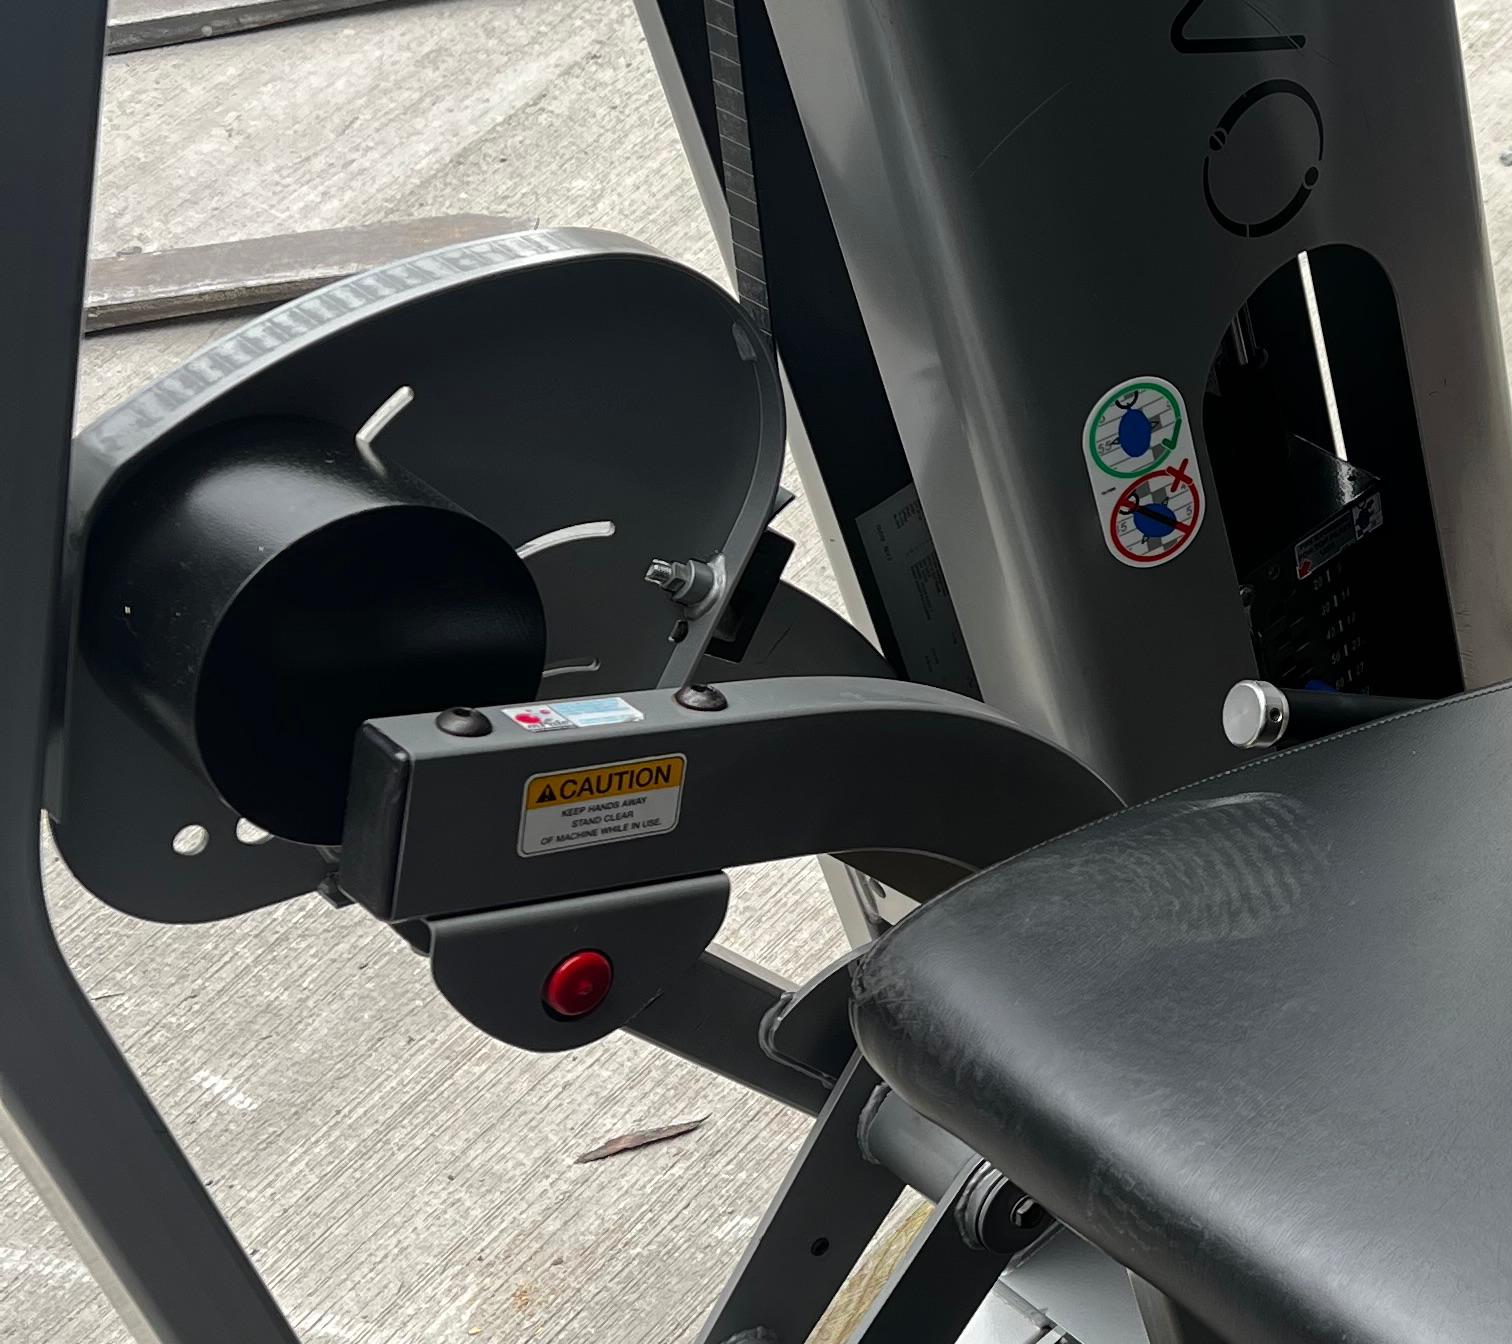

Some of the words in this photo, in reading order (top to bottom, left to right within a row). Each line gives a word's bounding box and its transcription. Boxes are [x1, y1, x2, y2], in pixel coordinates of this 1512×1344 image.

[560, 765, 672, 800] CAUTION
[561, 805, 587, 818] KEEP
[588, 801, 620, 814] HANDS
[622, 796, 648, 809] AWAY
[571, 816, 602, 828] STAND
[604, 811, 635, 823] CLEAR
[540, 836, 555, 846] OF
[556, 829, 599, 843] MACHINE
[600, 823, 629, 835] WHILE
[631, 821, 641, 830] IN
